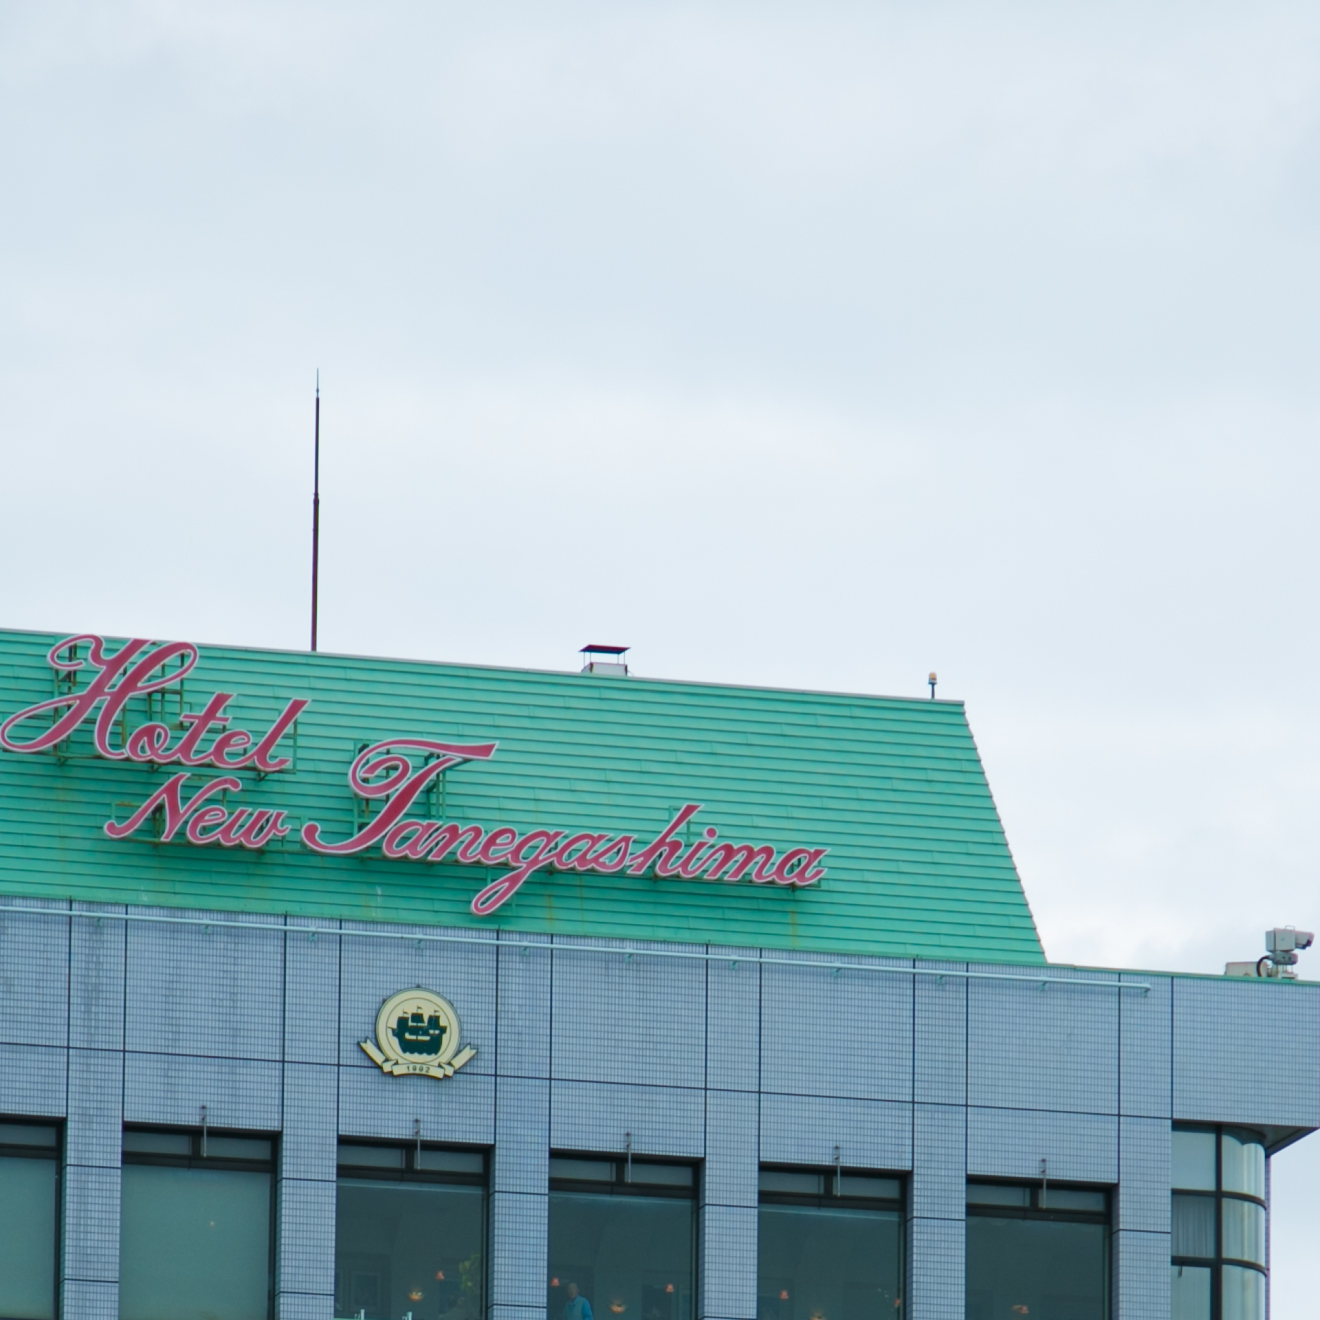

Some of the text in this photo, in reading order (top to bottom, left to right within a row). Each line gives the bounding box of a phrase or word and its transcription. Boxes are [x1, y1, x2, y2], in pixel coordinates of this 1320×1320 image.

[0, 635, 311, 771] Hotel
[105, 739, 831, 916] New Tanegashima
